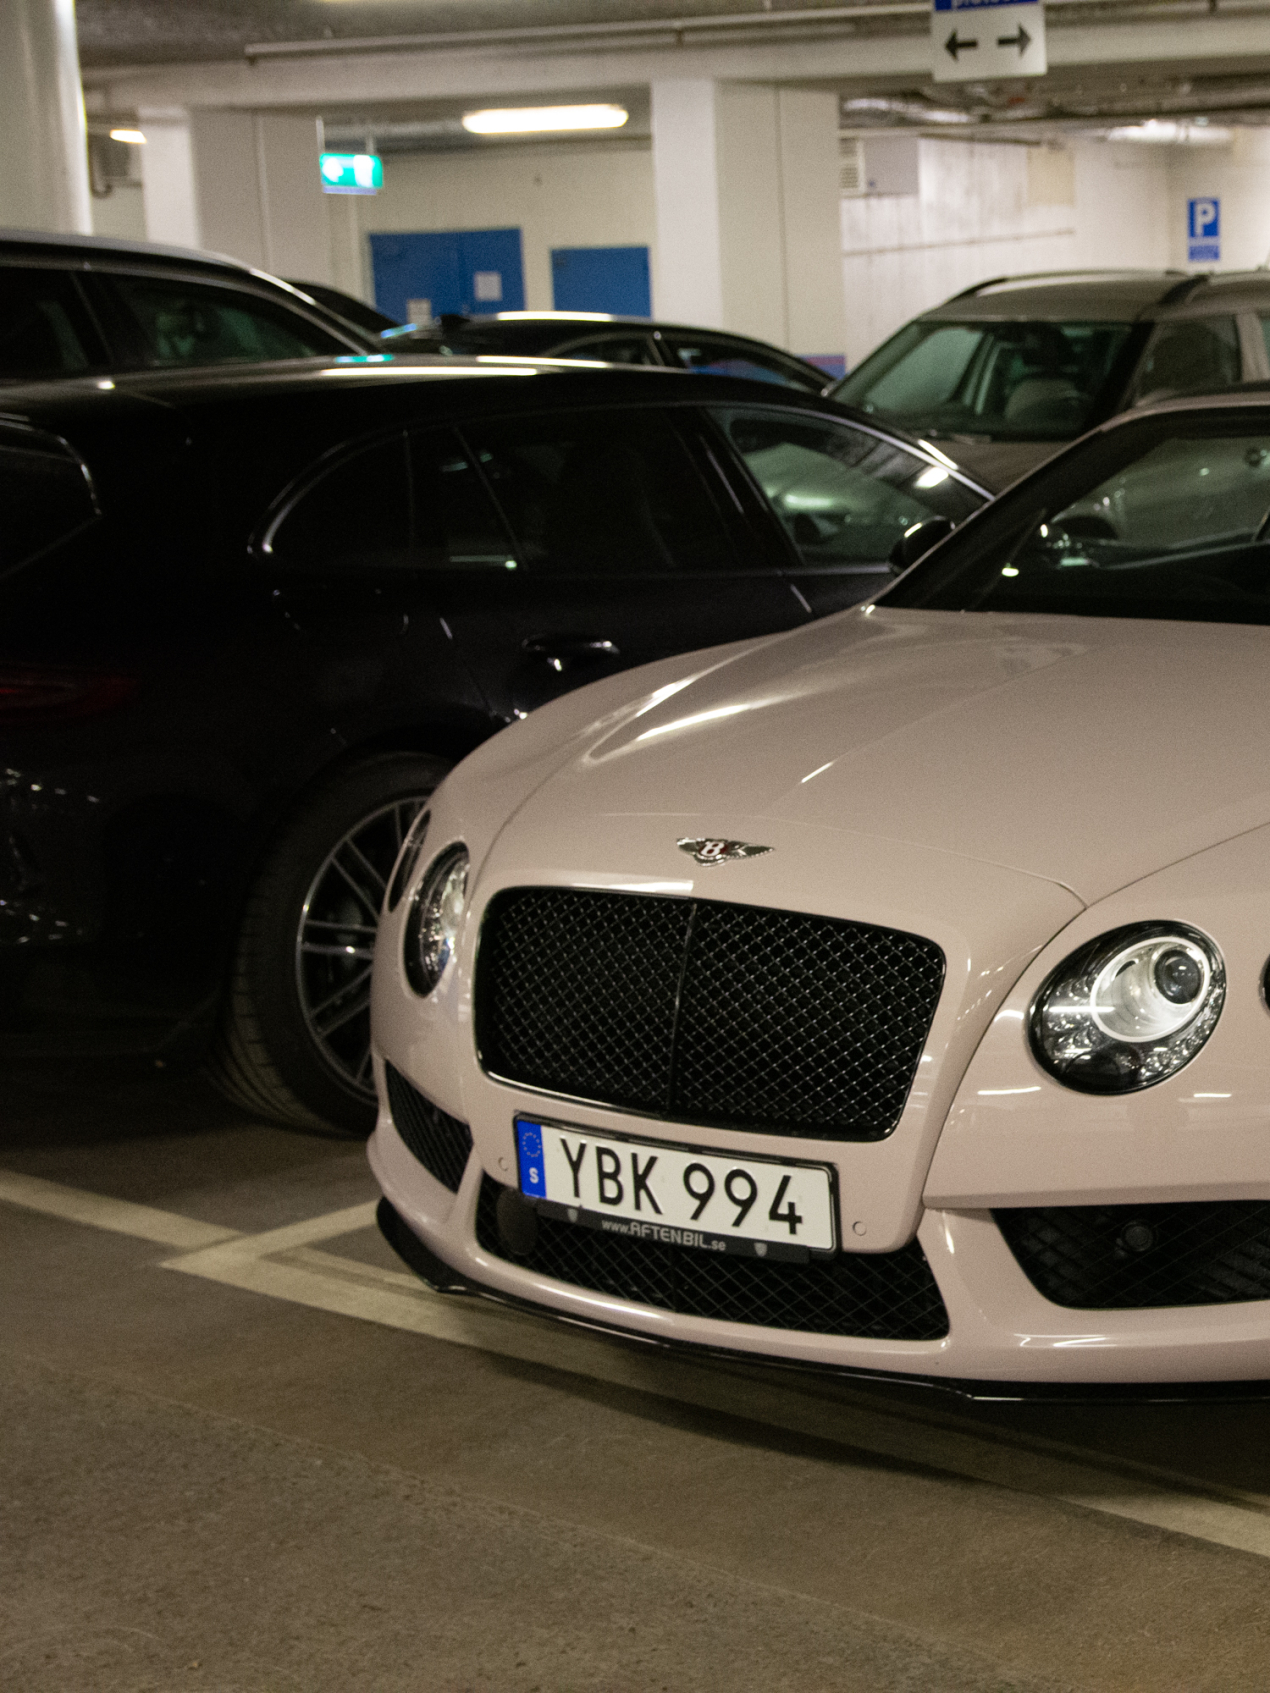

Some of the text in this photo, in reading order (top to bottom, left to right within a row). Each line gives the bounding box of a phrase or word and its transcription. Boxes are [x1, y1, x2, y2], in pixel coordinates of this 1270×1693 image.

[1195, 202, 1217, 236] P
[701, 841, 725, 856] B
[529, 1167, 539, 1184] S
[560, 1138, 803, 1235] YBK 994
[601, 1220, 727, 1251] www.AFTENBIL.se
